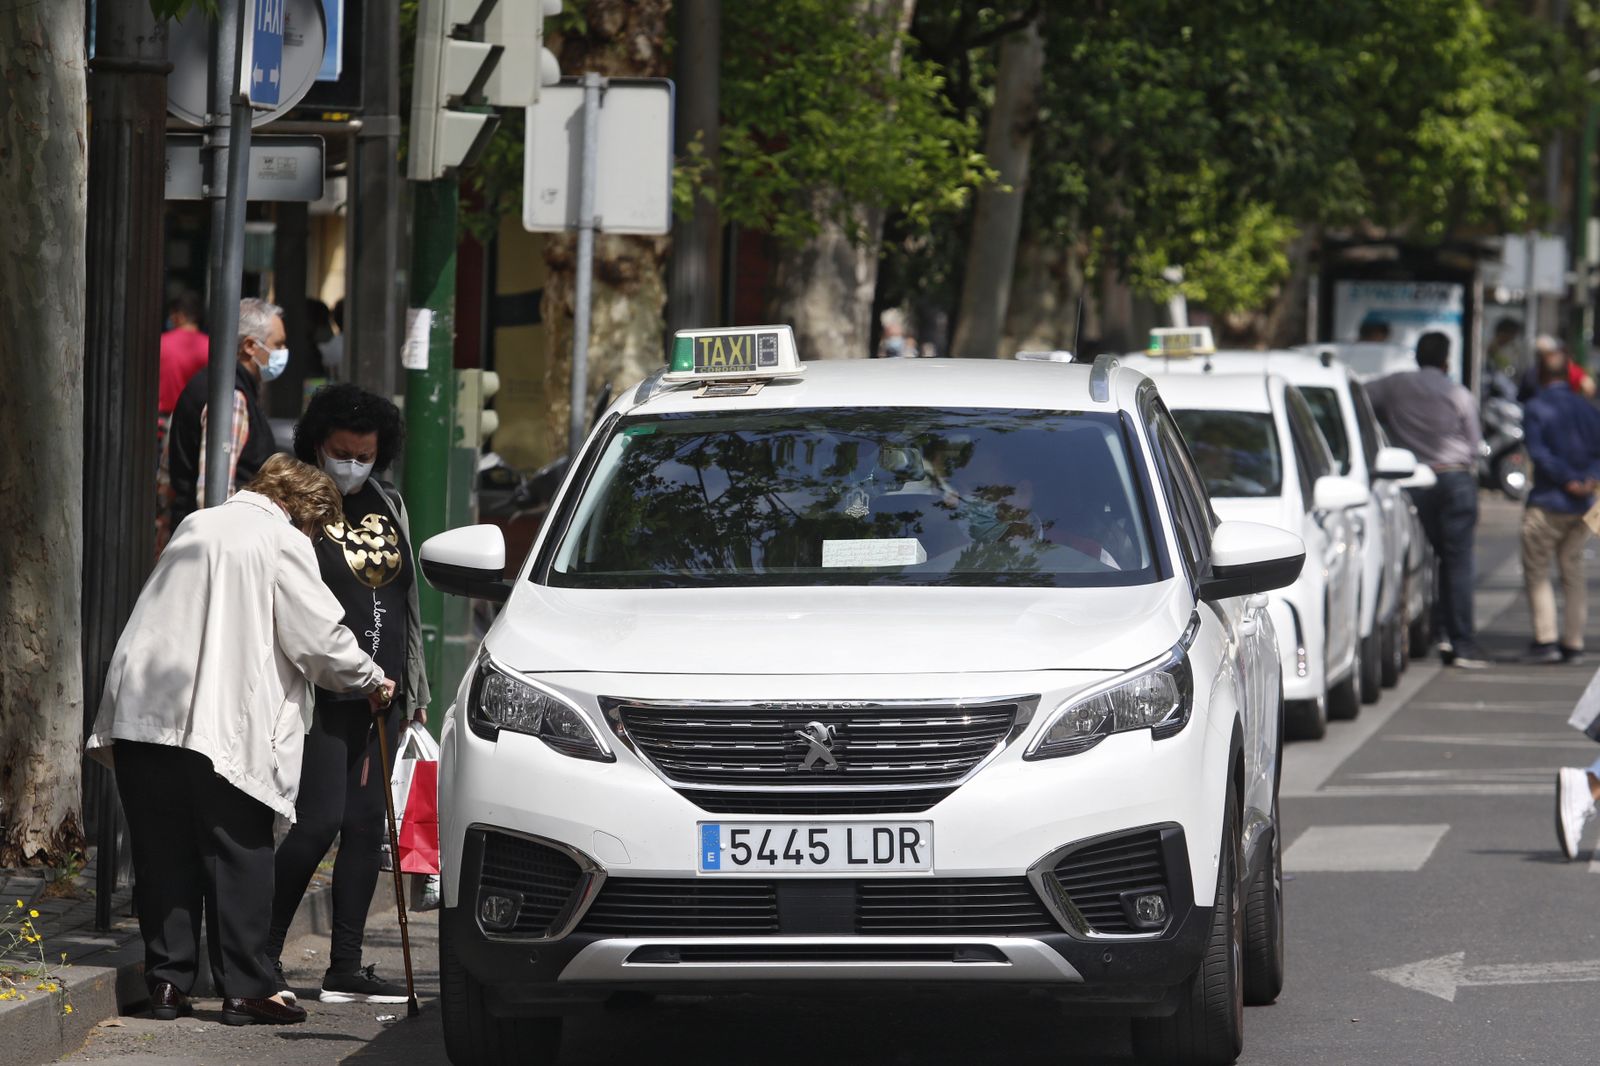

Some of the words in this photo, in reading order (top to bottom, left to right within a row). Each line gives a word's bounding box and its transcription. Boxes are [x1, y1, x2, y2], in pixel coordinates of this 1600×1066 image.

[699, 335, 751, 367] TAXI
[707, 852, 715, 862] E
[730, 828, 830, 866] 5445
[846, 827, 921, 865] LDR
